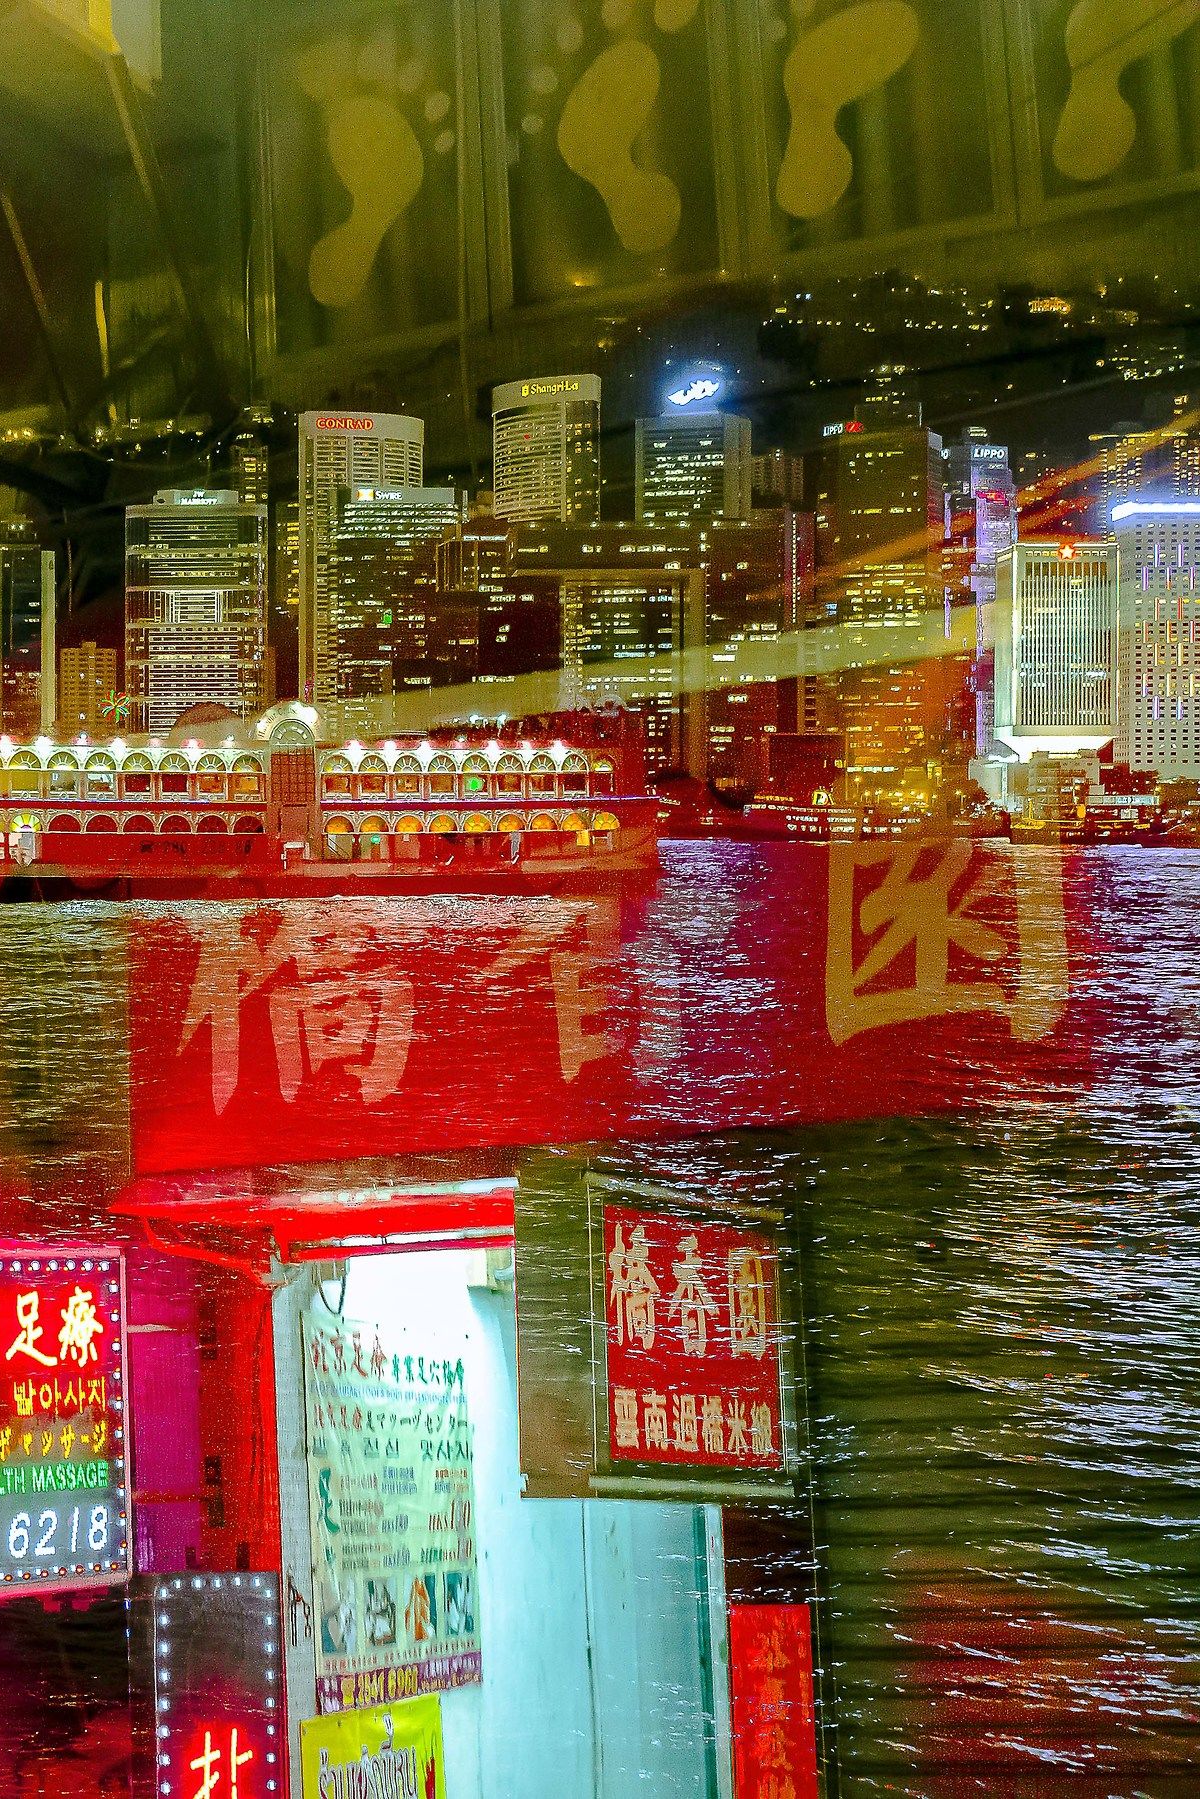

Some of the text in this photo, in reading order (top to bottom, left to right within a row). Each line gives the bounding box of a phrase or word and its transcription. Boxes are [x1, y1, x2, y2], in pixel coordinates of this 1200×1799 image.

[530, 381, 580, 397] Shangri-La
[316, 417, 374, 431] CONRAD
[823, 423, 844, 437] LIPPO
[973, 448, 1006, 459] LIPPO
[614, 1387, 773, 1457] 雲南過橋米線
[32, 1461, 109, 1493] MASSAGE
[8, 1505, 109, 1559] 6218
